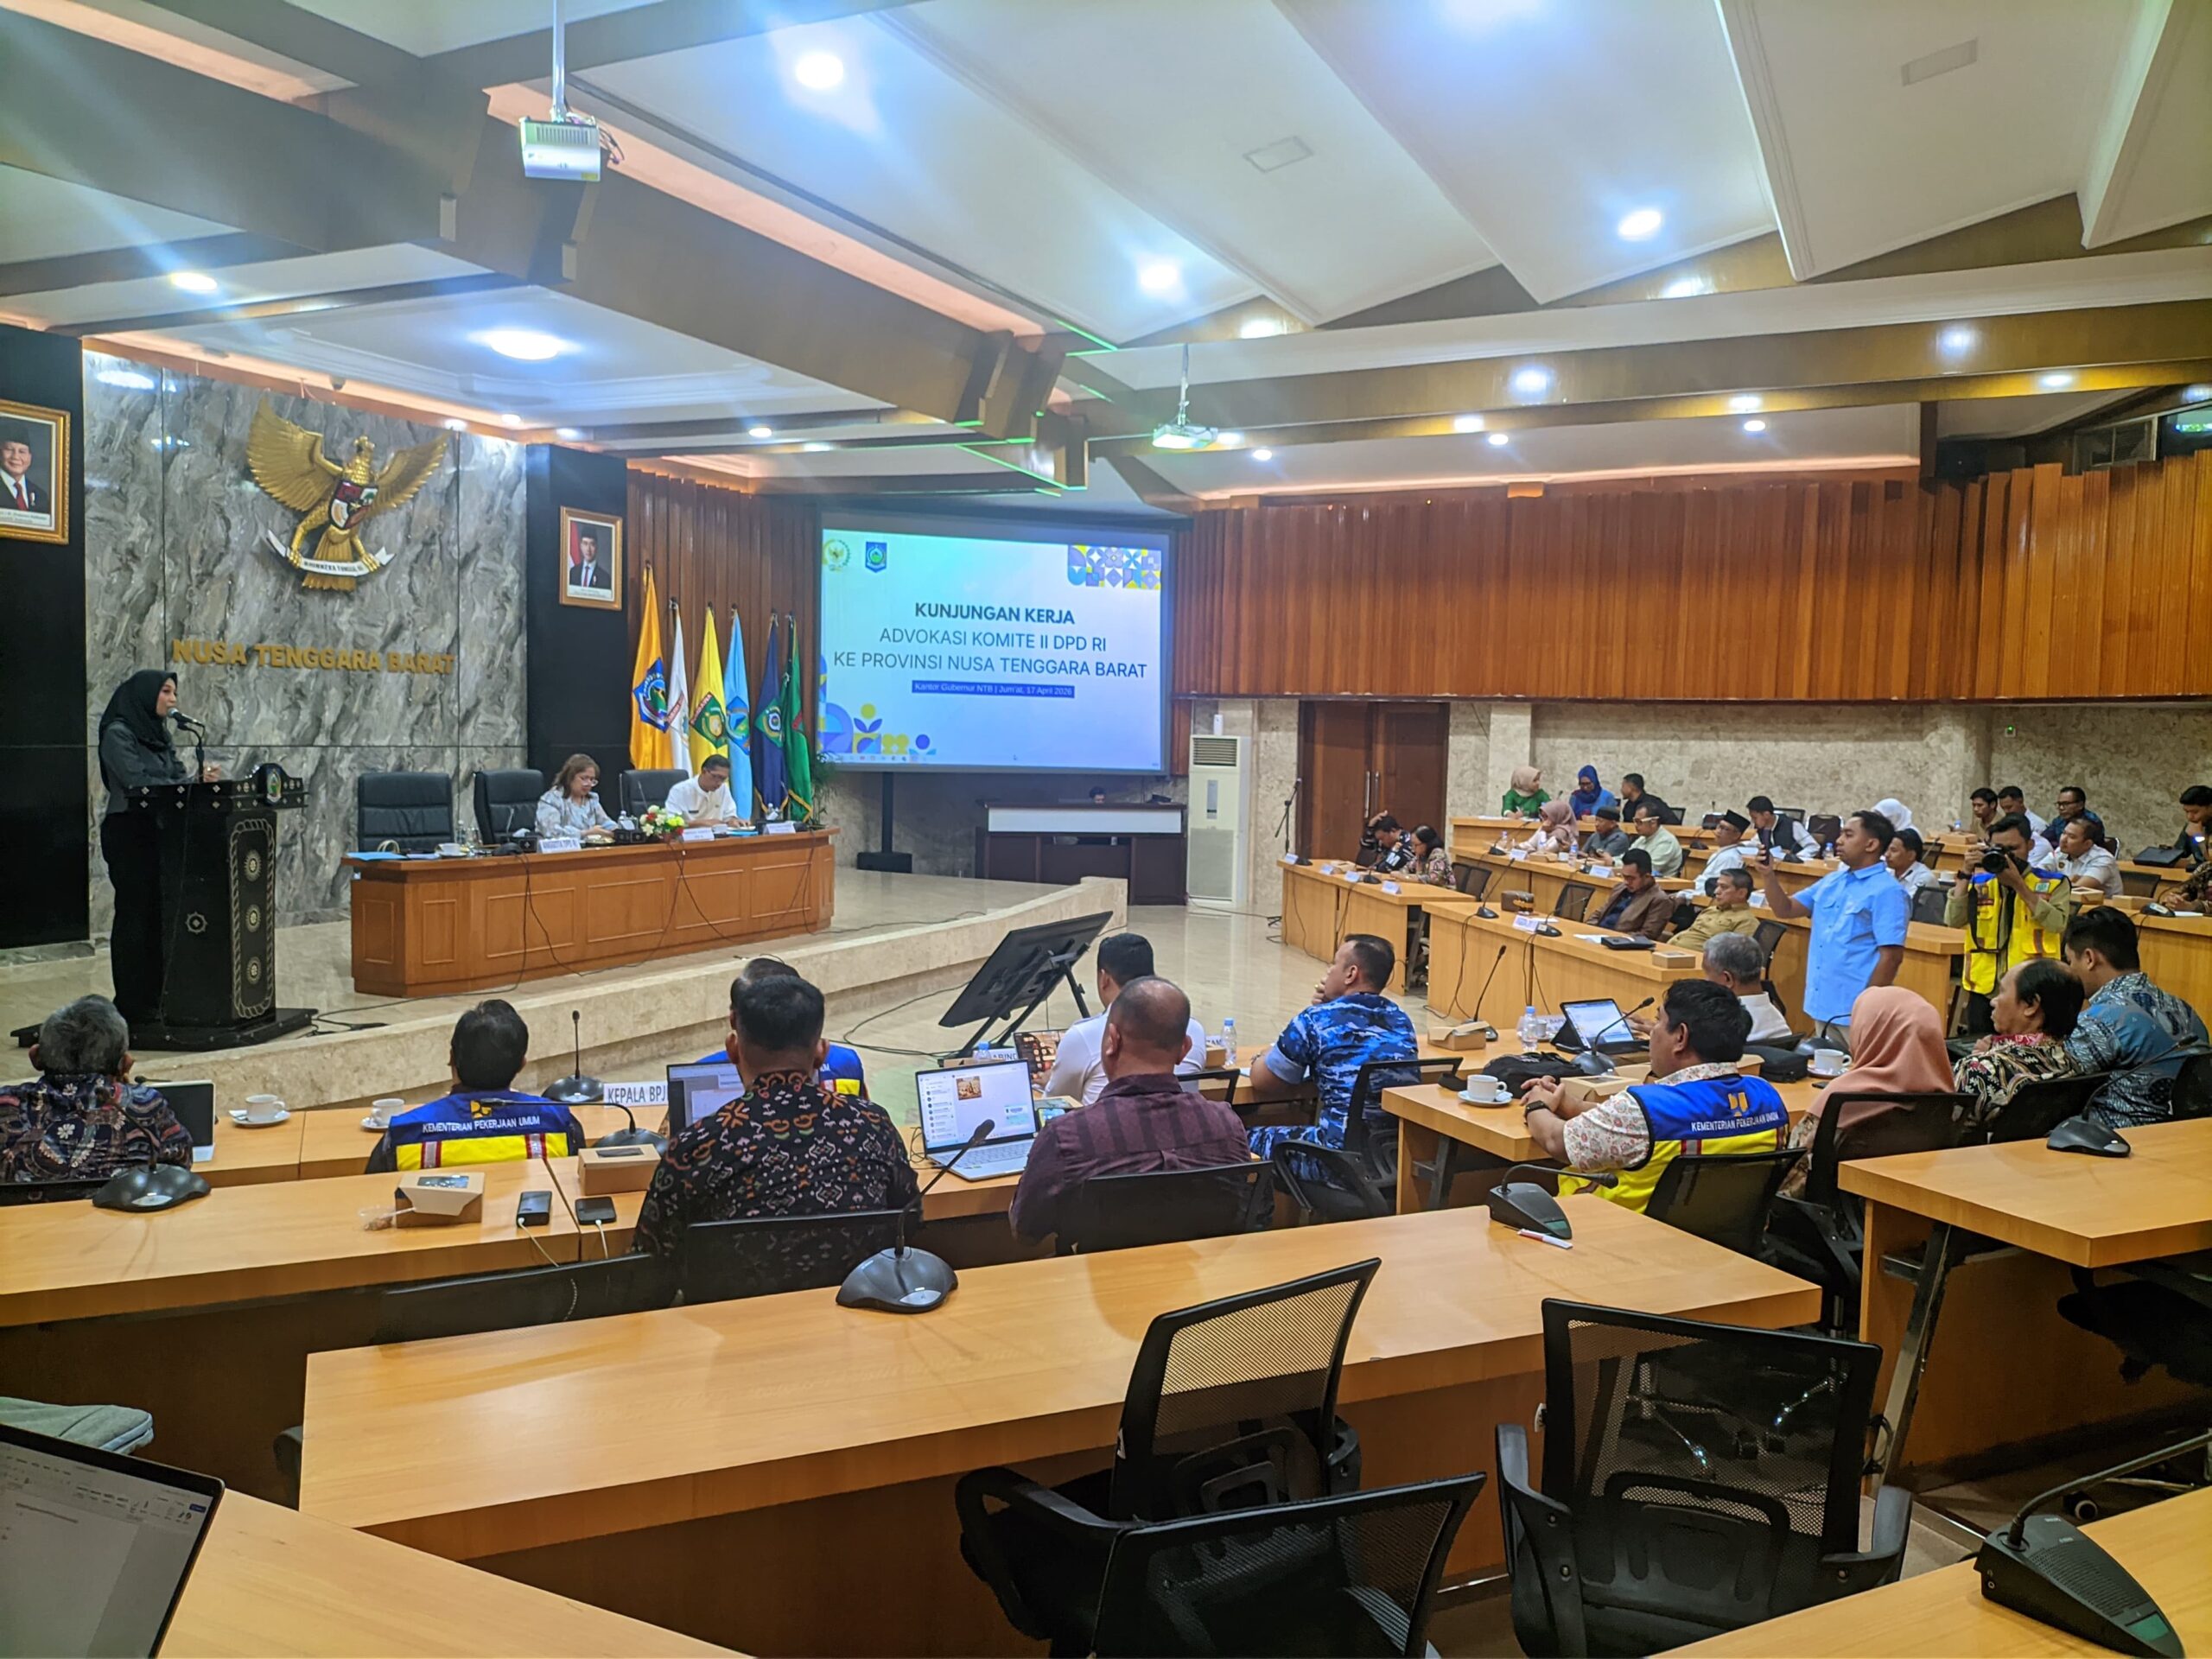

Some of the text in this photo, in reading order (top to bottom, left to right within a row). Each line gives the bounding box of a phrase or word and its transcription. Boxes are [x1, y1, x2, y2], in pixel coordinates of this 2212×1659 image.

[915, 602, 1075, 624] KUNJUNGAN KERJA
[880, 628, 1107, 652] ADVOKASI KOMITE II DPD RI
[172, 638, 455, 675] NUSA TENGGARA BARAT
[834, 652, 1148, 678] KE PROVINSI NUSA TENGGARA BARAT
[915, 683, 939, 691] Kantor
[941, 683, 975, 692] Gubernur
[976, 684, 994, 694] NTB
[1026, 686, 1036, 695] 17
[1037, 686, 1054, 696] April
[608, 1086, 645, 1104] KEPALA
[423, 1116, 541, 1134] KEMENTERIAN PEKERJAAN UMUM
[1691, 1111, 1779, 1133] KEMENTERIAN PEKERJAAN UMUM
